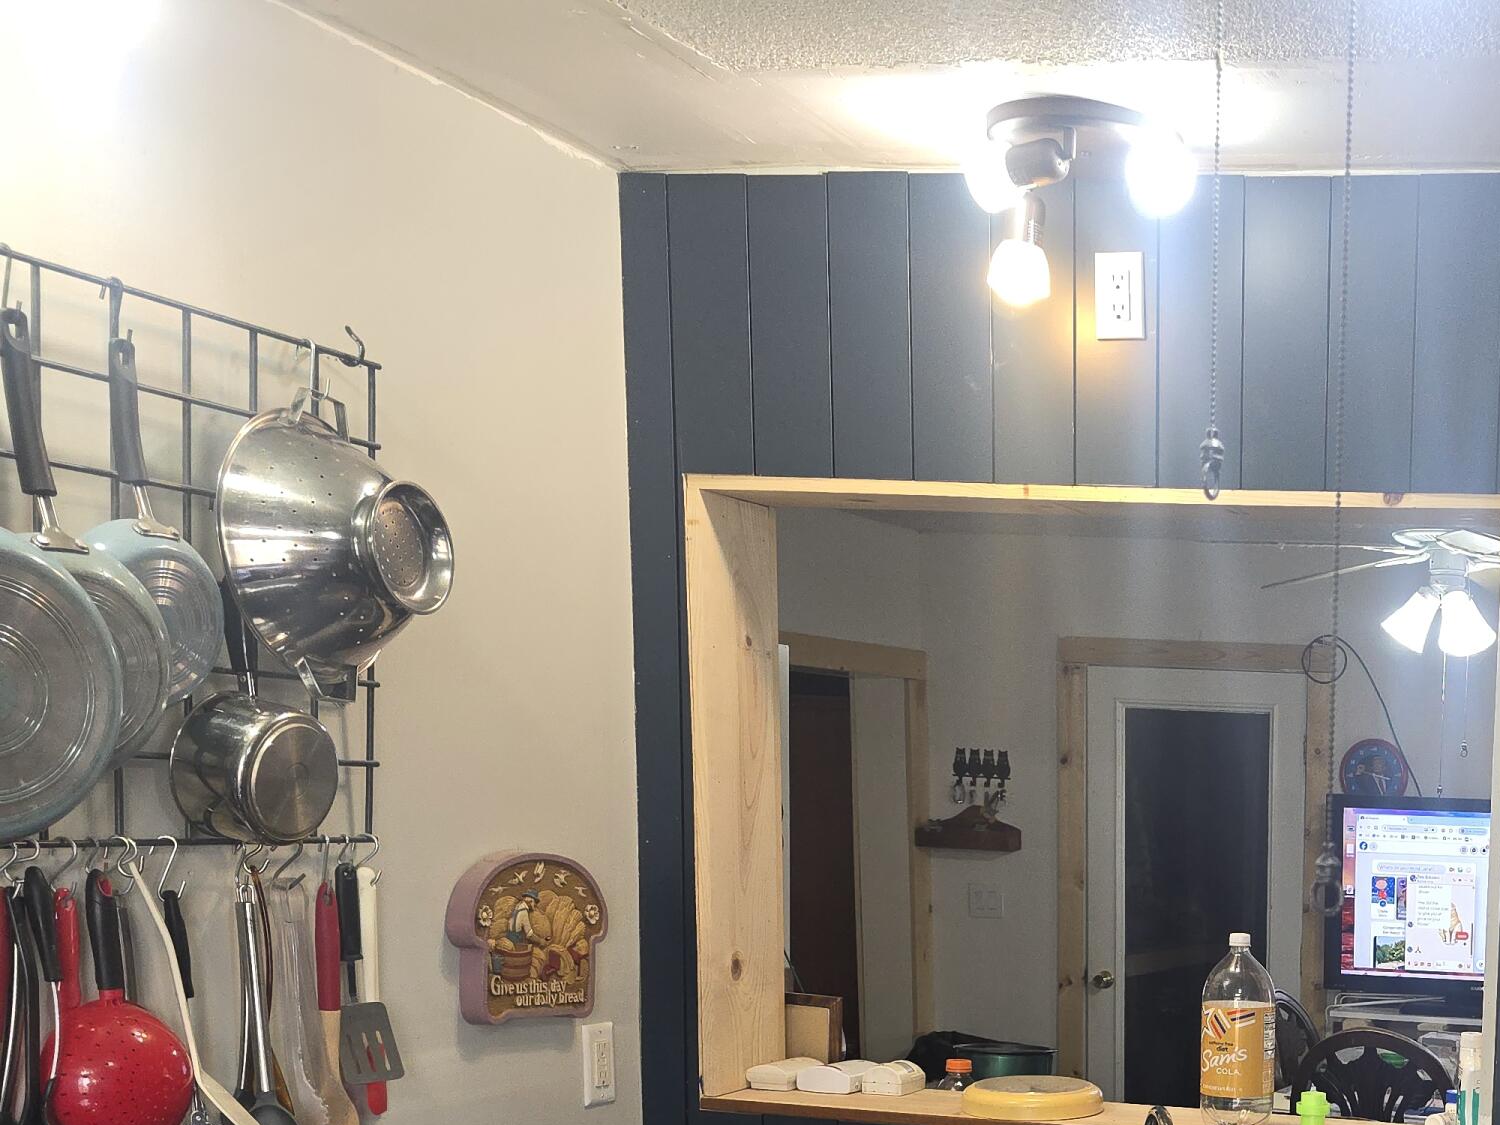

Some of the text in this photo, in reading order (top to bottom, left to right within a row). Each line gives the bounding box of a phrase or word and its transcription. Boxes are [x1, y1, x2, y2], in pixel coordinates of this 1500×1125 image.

[490, 974, 567, 996] Give us this day
[516, 994, 533, 1007] our
[534, 990, 558, 1008] daily
[1202, 1047, 1247, 1072] Sam's
[1215, 1067, 1241, 1076] COLA
